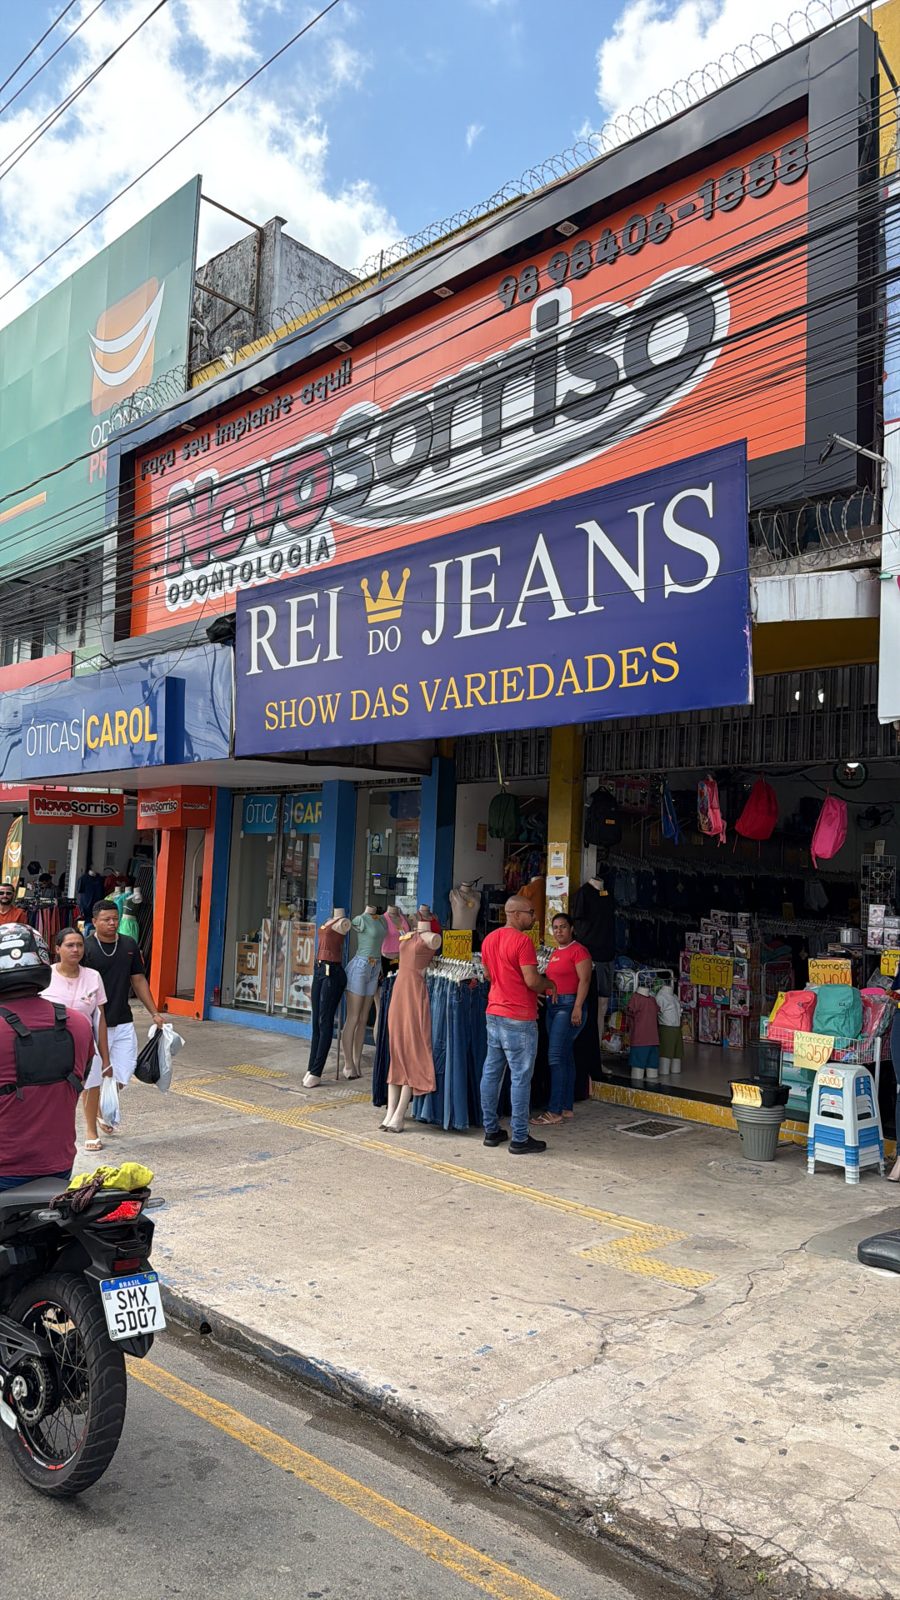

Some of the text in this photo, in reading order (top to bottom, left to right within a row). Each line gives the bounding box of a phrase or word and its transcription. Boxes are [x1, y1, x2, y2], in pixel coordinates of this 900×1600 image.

[499, 137, 808, 311] 98 98406-1888
[181, 434, 210, 461] seu
[215, 393, 294, 447] implante
[168, 535, 331, 604] ODONTOLOGIA
[246, 483, 721, 676] REI DO JEANS
[265, 641, 680, 731] SHOW DAS VARIEDADES
[86, 705, 157, 749] CAROL
[116, 1285, 150, 1311] SMX
[118, 1279, 141, 1289] BRASIL
[114, 1306, 157, 1334] 5D07
